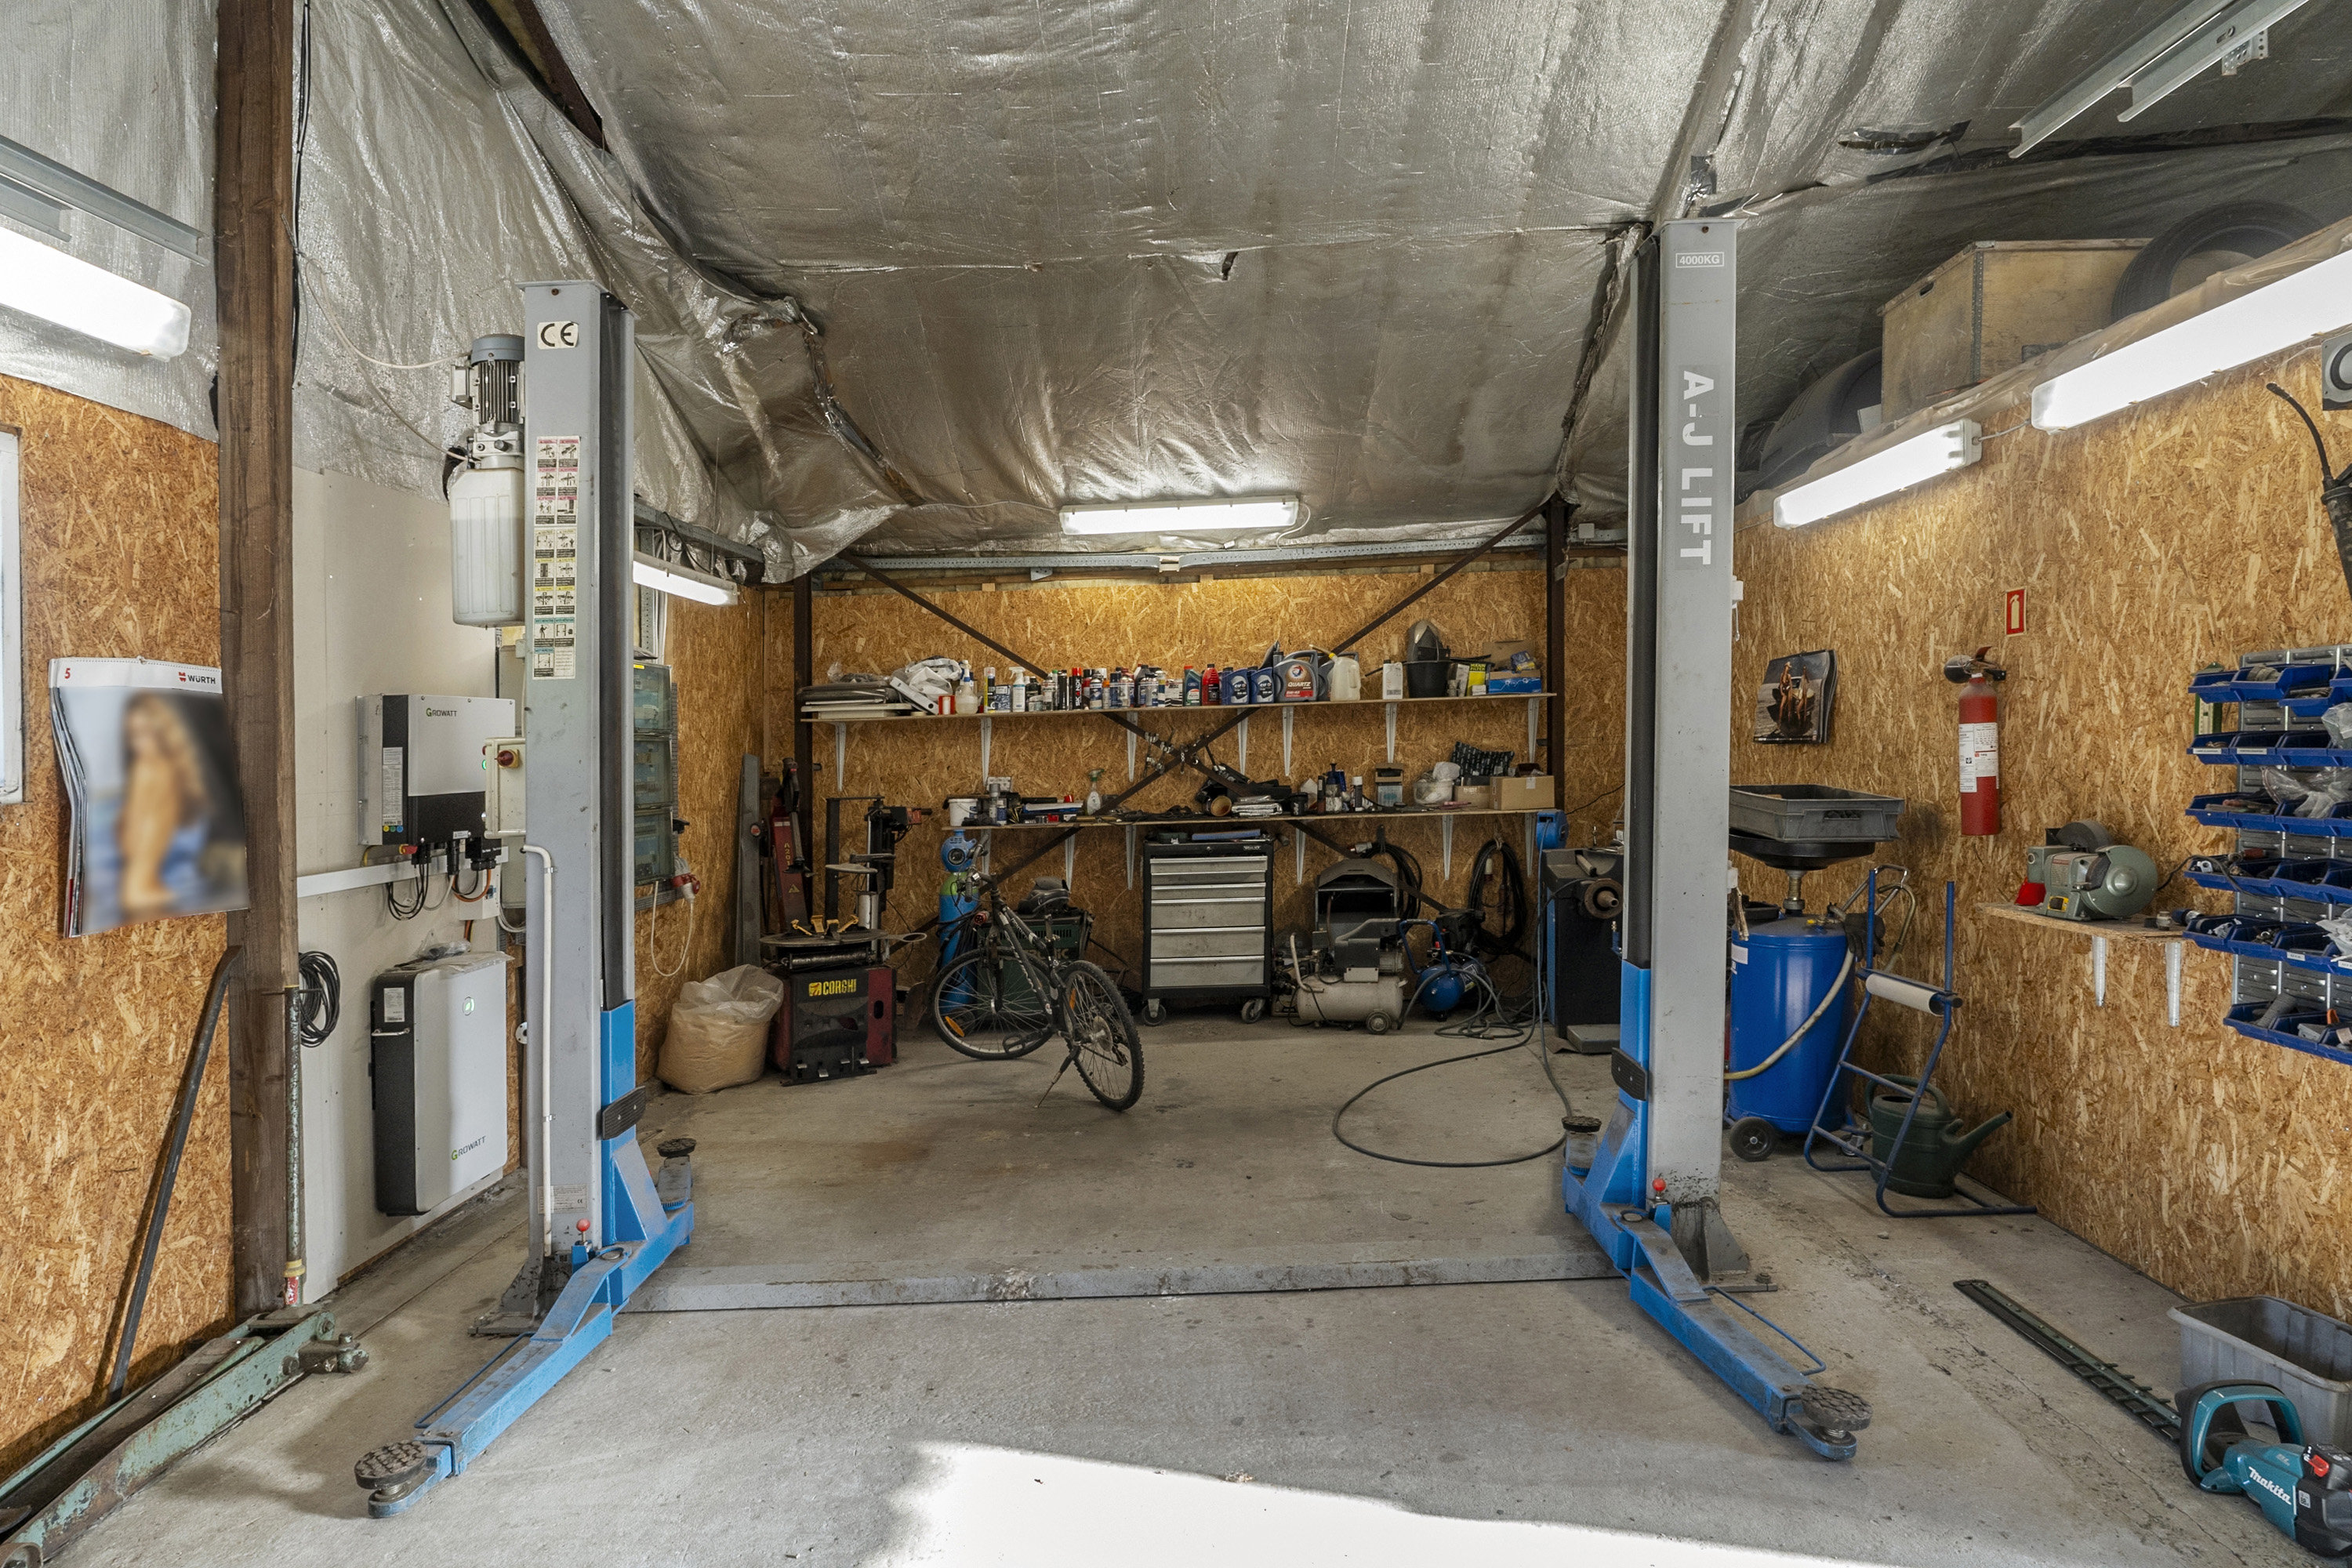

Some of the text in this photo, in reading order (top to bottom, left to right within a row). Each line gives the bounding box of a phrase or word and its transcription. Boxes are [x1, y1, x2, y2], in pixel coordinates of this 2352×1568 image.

[1679, 255, 1720, 265] 4000KG
[540, 323, 574, 347] CE
[1680, 370, 1715, 564] A-J LIFT
[64, 668, 71, 679] 5
[187, 674, 216, 684] WÜRTH
[426, 707, 458, 717] GROWATT
[822, 978, 857, 995] CORGHI
[451, 1135, 486, 1160] GROWATT
